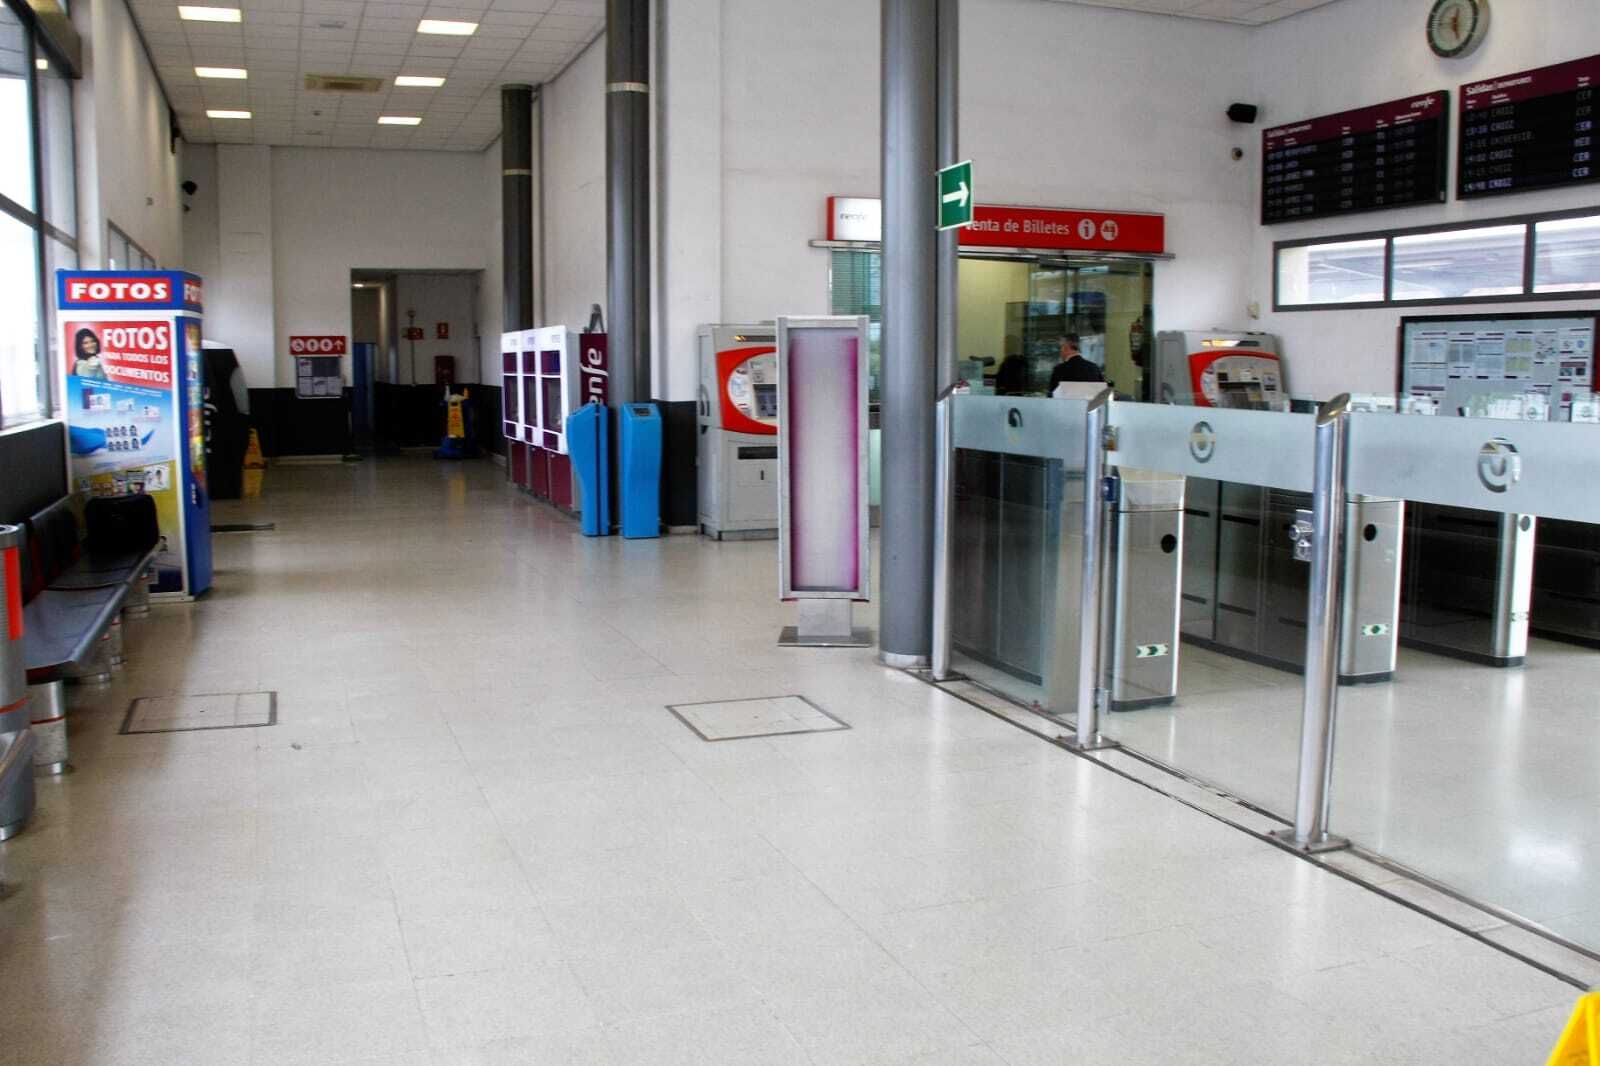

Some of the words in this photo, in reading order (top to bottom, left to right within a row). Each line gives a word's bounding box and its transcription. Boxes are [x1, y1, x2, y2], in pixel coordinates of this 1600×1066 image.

[1003, 219, 1020, 232] de
[1023, 219, 1071, 235] Billetes
[71, 282, 168, 299] FOTOS
[103, 326, 168, 350] FOTOS
[151, 355, 168, 365] LOS
